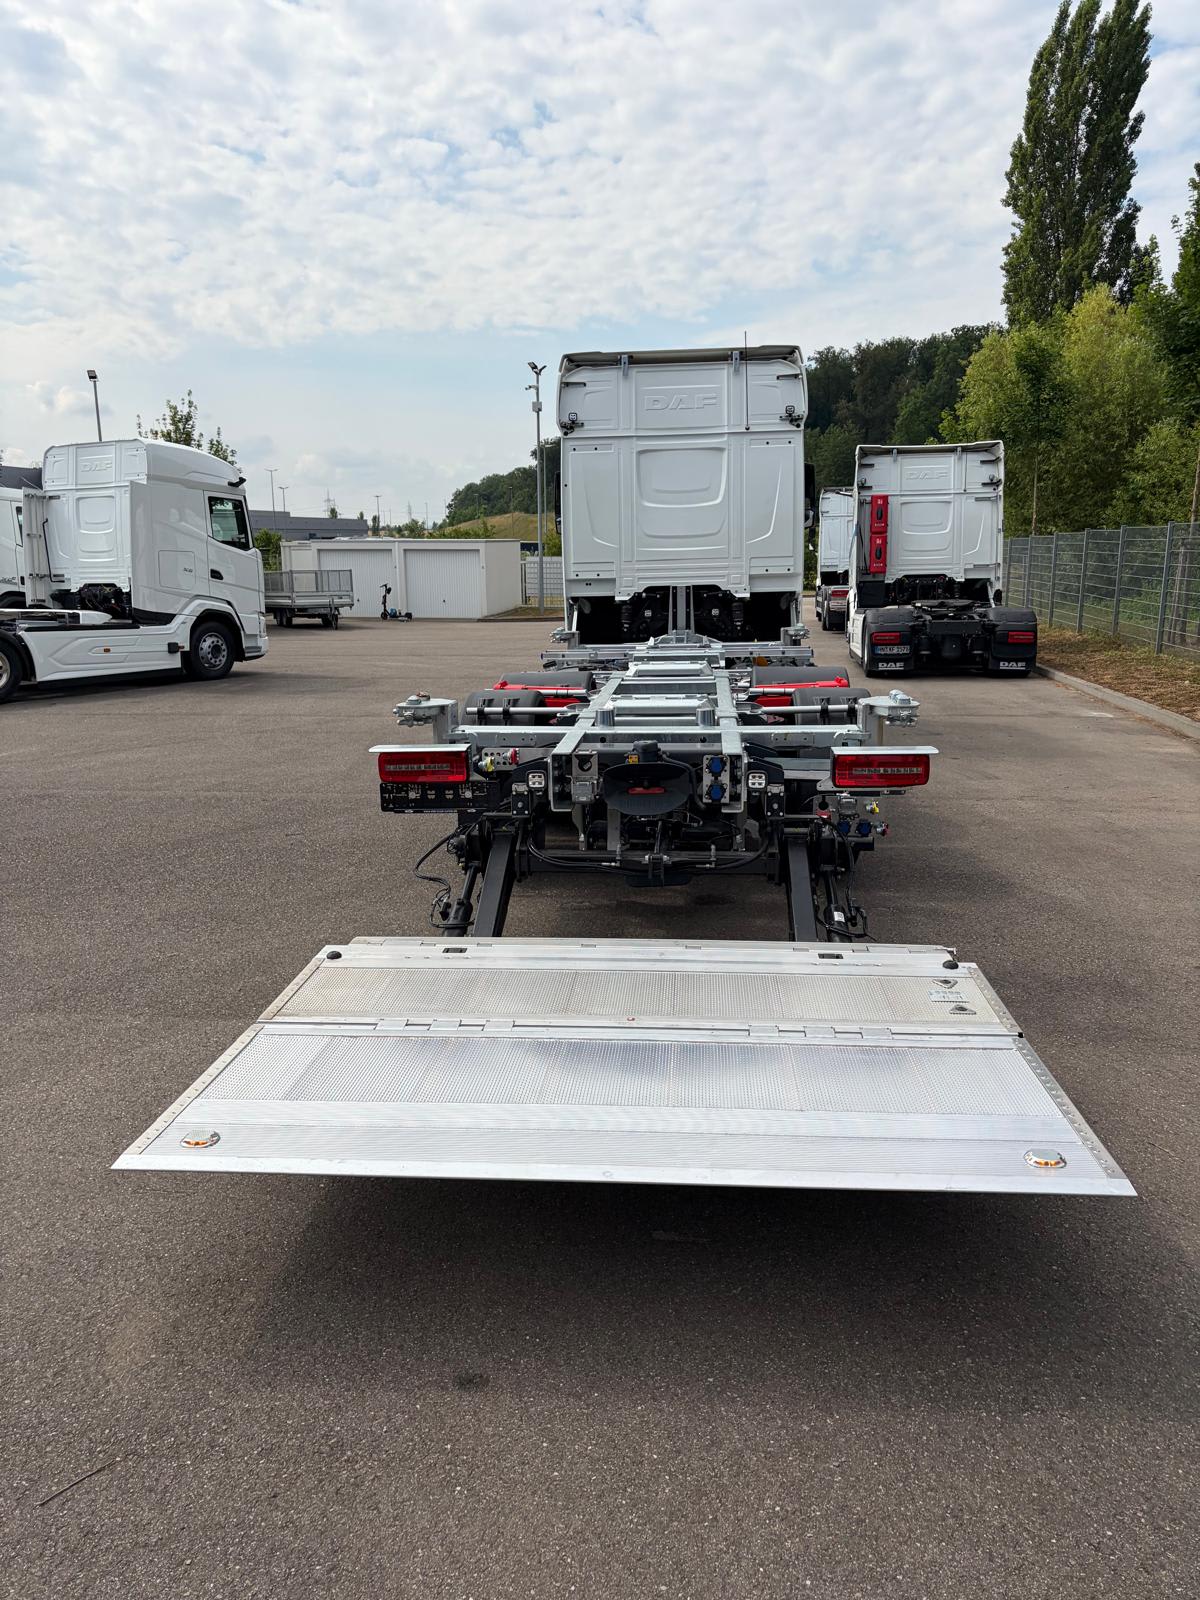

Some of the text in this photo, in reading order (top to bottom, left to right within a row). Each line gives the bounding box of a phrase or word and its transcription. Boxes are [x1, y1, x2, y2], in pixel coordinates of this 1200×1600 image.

[645, 393, 720, 411] DAF
[903, 470, 948, 480] DAF
[999, 661, 1026, 669] DAF
